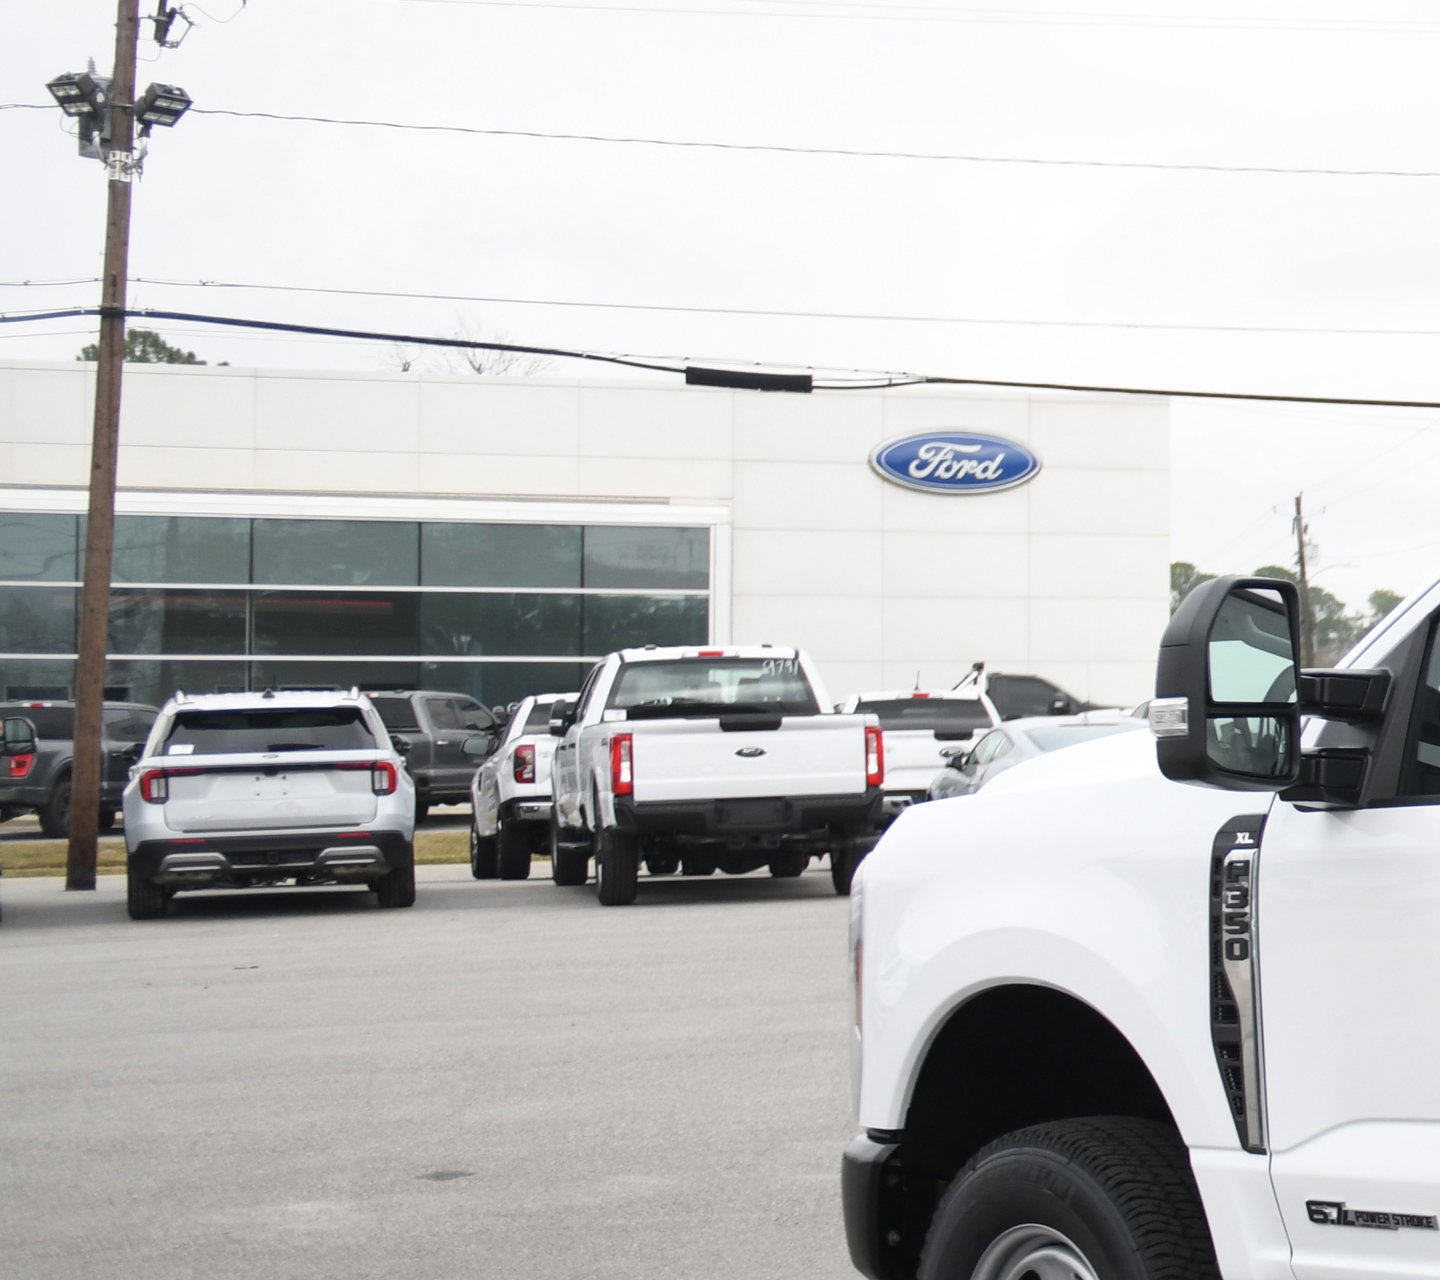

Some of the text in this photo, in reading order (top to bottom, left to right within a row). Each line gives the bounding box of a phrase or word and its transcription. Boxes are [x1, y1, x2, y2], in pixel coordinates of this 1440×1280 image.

[909, 442, 1005, 480] Ford
[1235, 831, 1255, 844] XL
[1354, 1210, 1391, 1226] POWER
[1392, 1213, 1435, 1229] STROKE
